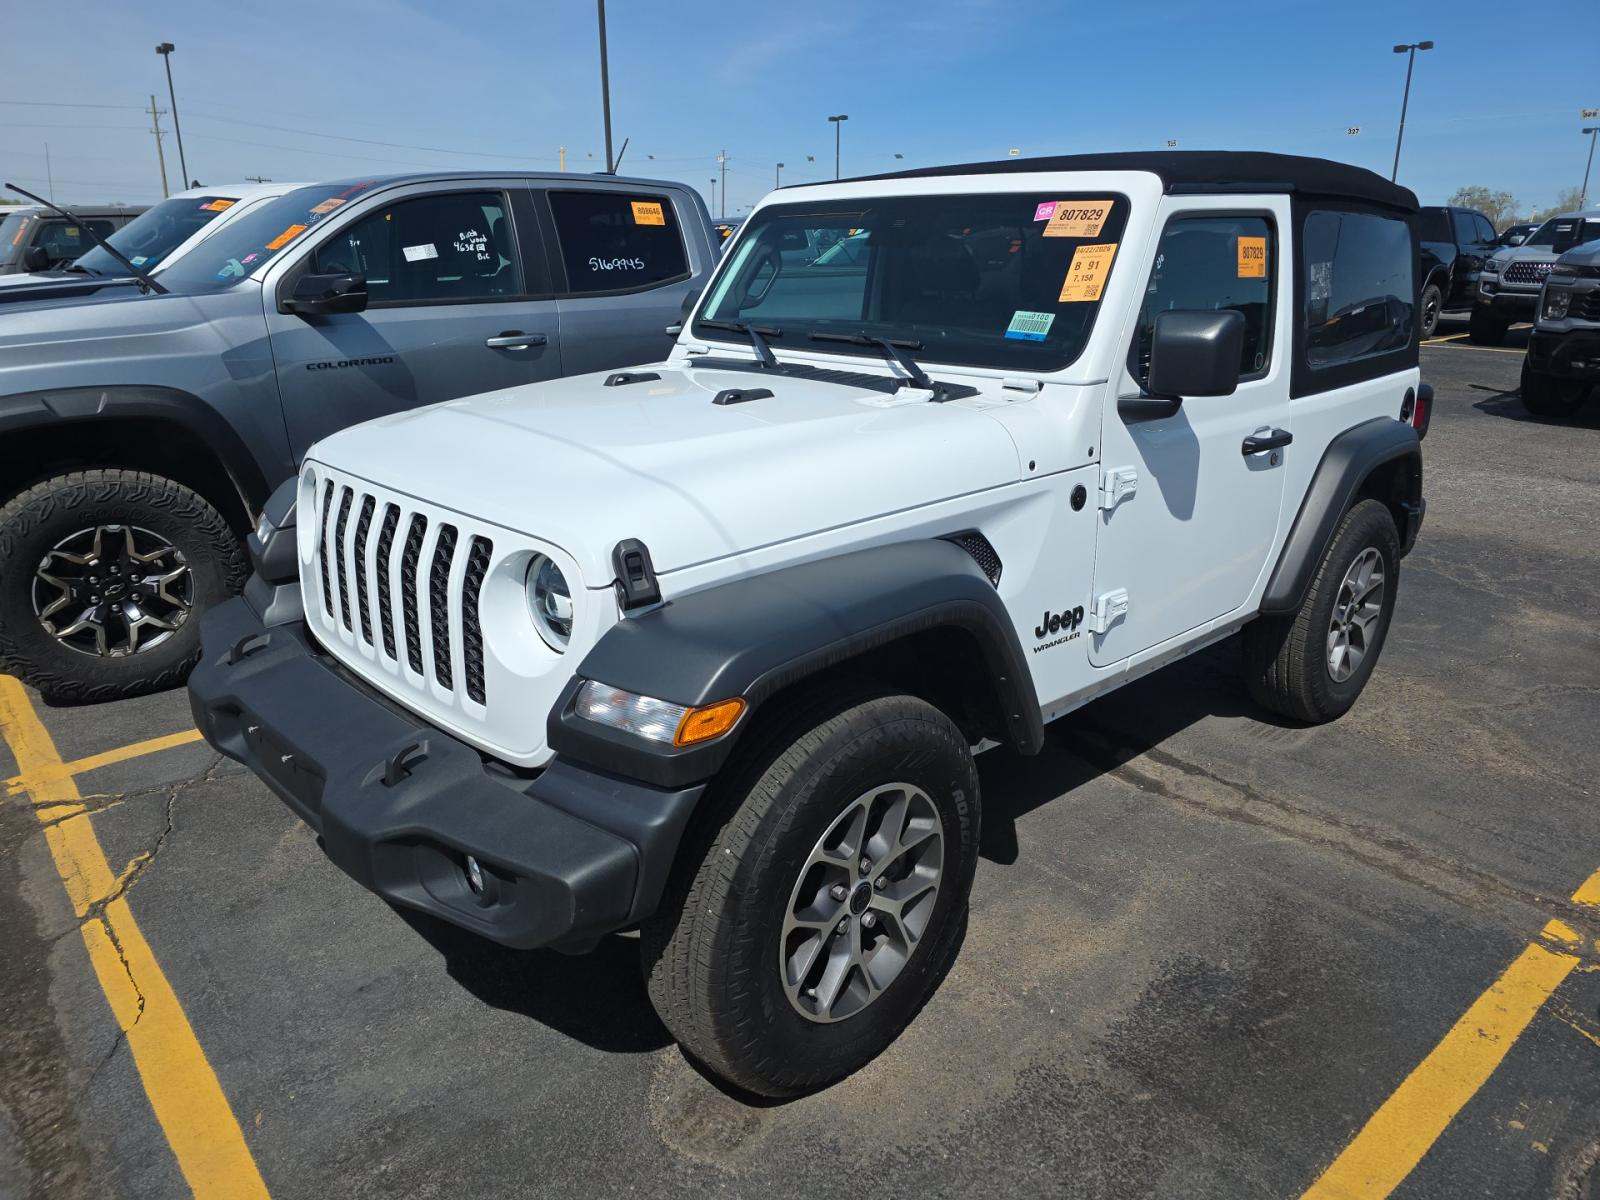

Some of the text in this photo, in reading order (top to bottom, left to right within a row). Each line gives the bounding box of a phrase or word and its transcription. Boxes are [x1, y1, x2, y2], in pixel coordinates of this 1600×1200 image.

[1059, 209, 1104, 221] 807829
[1242, 246, 1264, 259] 807829
[1087, 260, 1101, 271] 91
[305, 356, 394, 371] COLORADO
[1034, 604, 1085, 640] Jeep
[1033, 631, 1081, 654] WRANGLER
